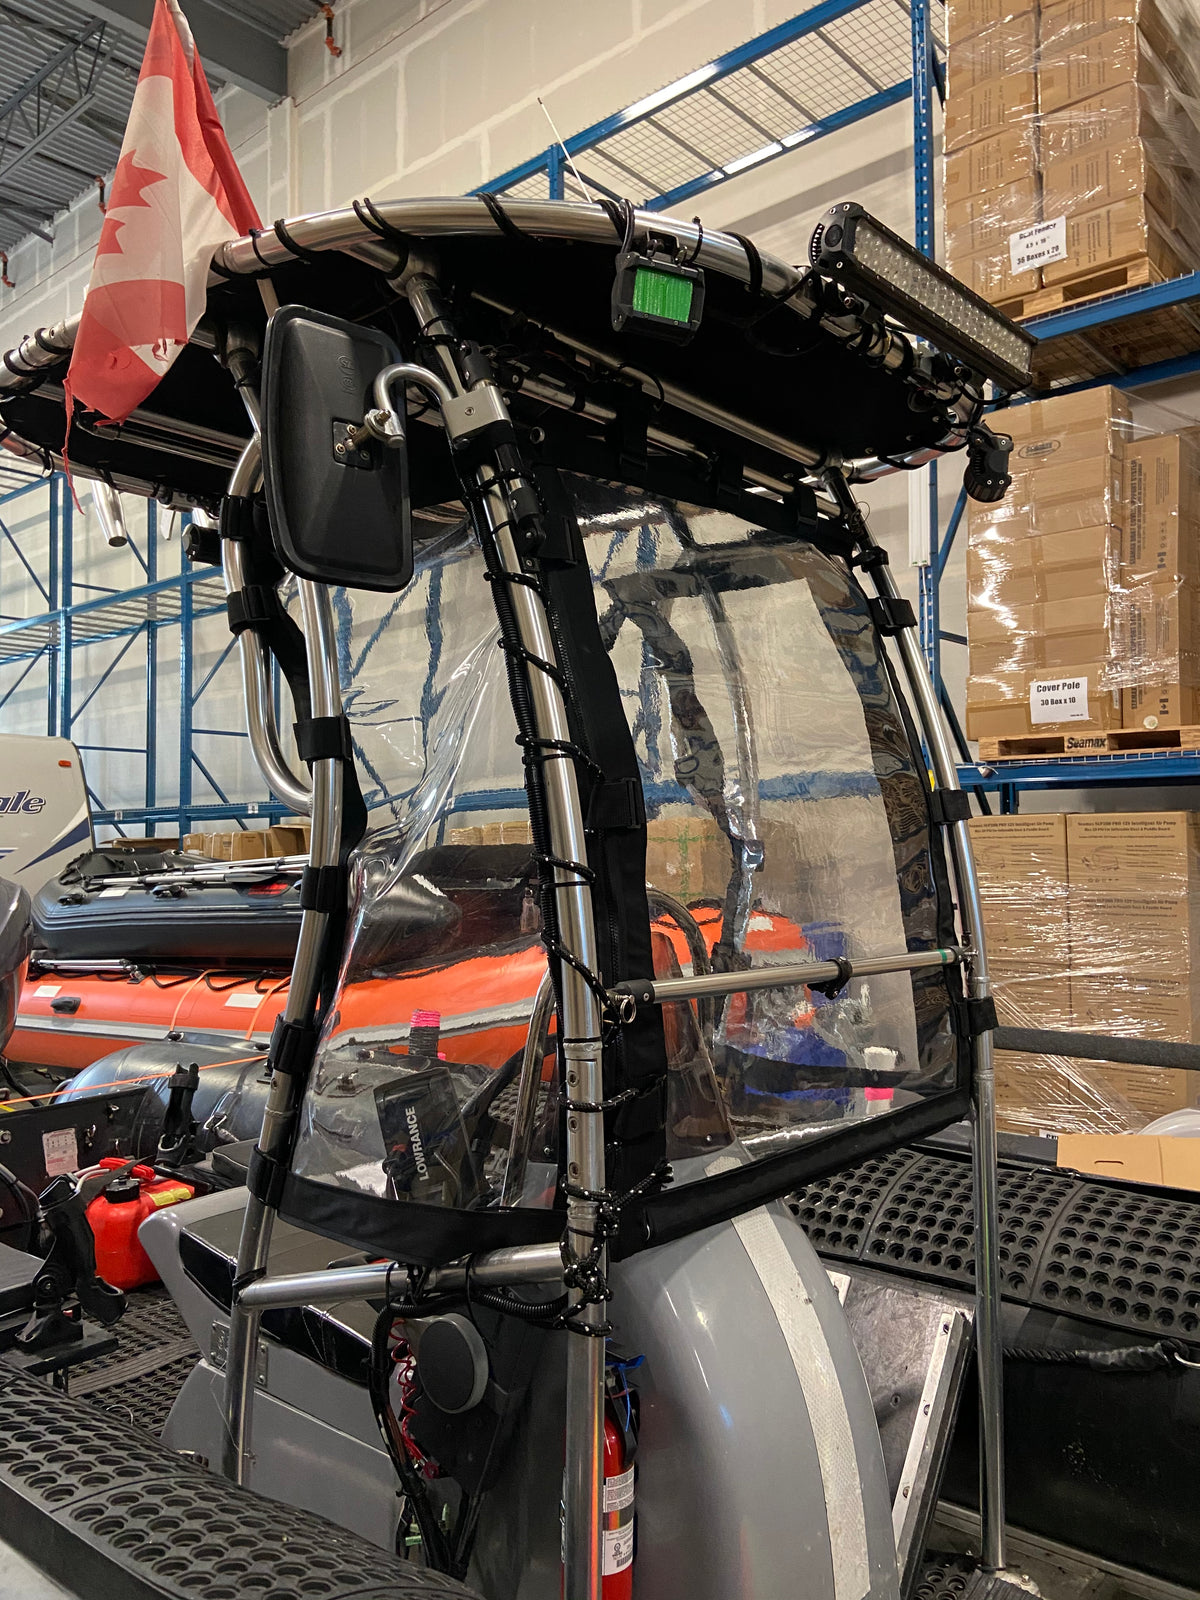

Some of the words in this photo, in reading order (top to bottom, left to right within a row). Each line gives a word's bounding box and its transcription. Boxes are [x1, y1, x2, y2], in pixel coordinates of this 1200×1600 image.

[1026, 251, 1046, 262] Boxes
[1036, 684, 1060, 693] Cover
[1062, 681, 1081, 690] Pole
[1066, 737, 1106, 749] Seamax
[405, 1106, 430, 1181] LOWRANCE
